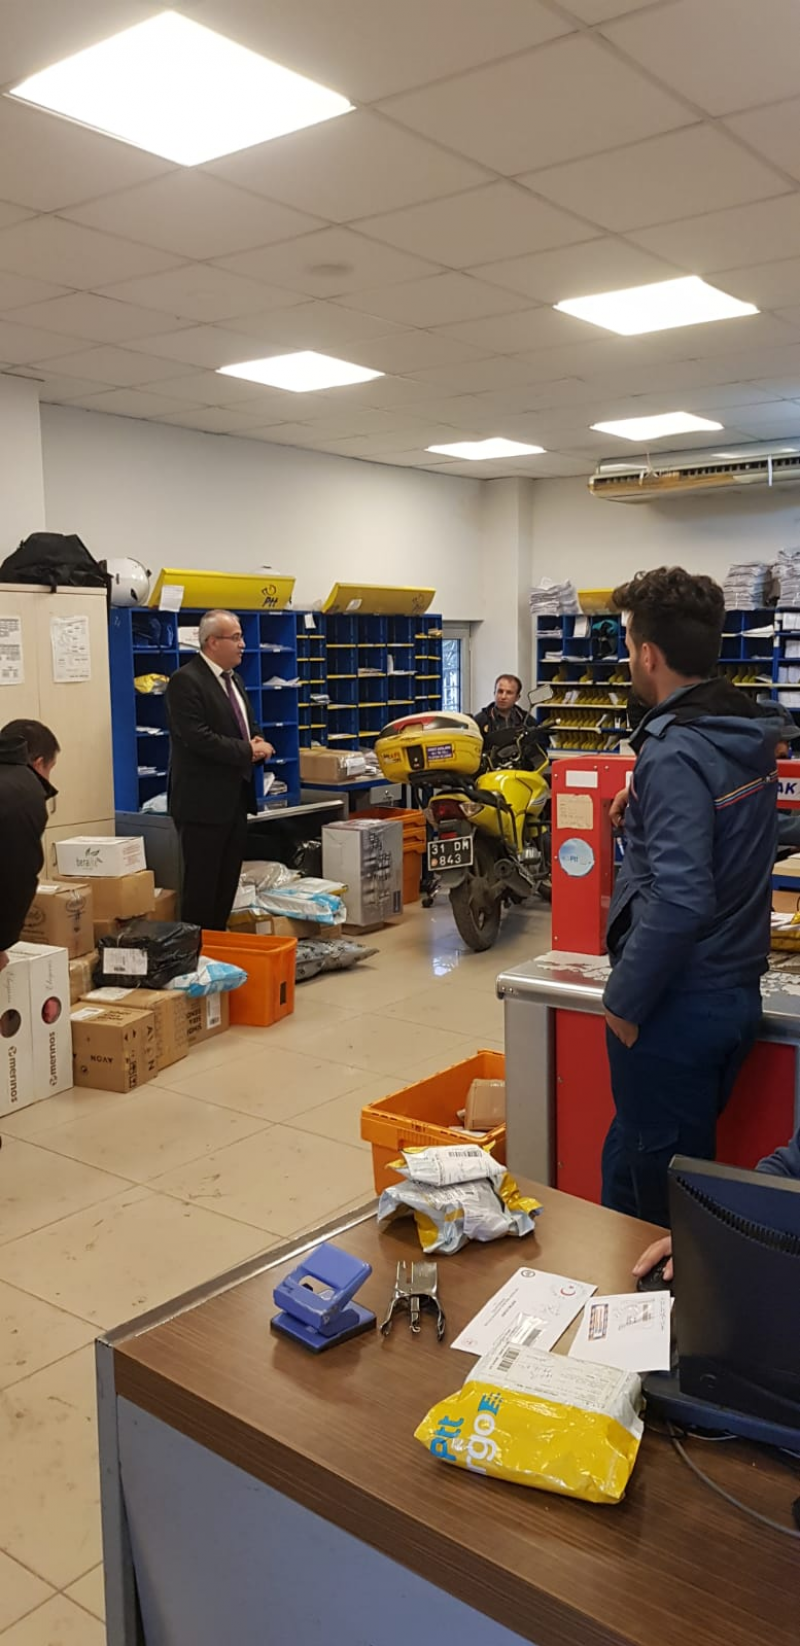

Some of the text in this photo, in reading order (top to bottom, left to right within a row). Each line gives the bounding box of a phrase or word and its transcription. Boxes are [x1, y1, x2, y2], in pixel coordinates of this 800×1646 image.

[431, 839, 470, 855] 31 DM
[439, 853, 461, 866] 843
[90, 1054, 113, 1064] AVON
[8, 1057, 18, 1104] merinos
